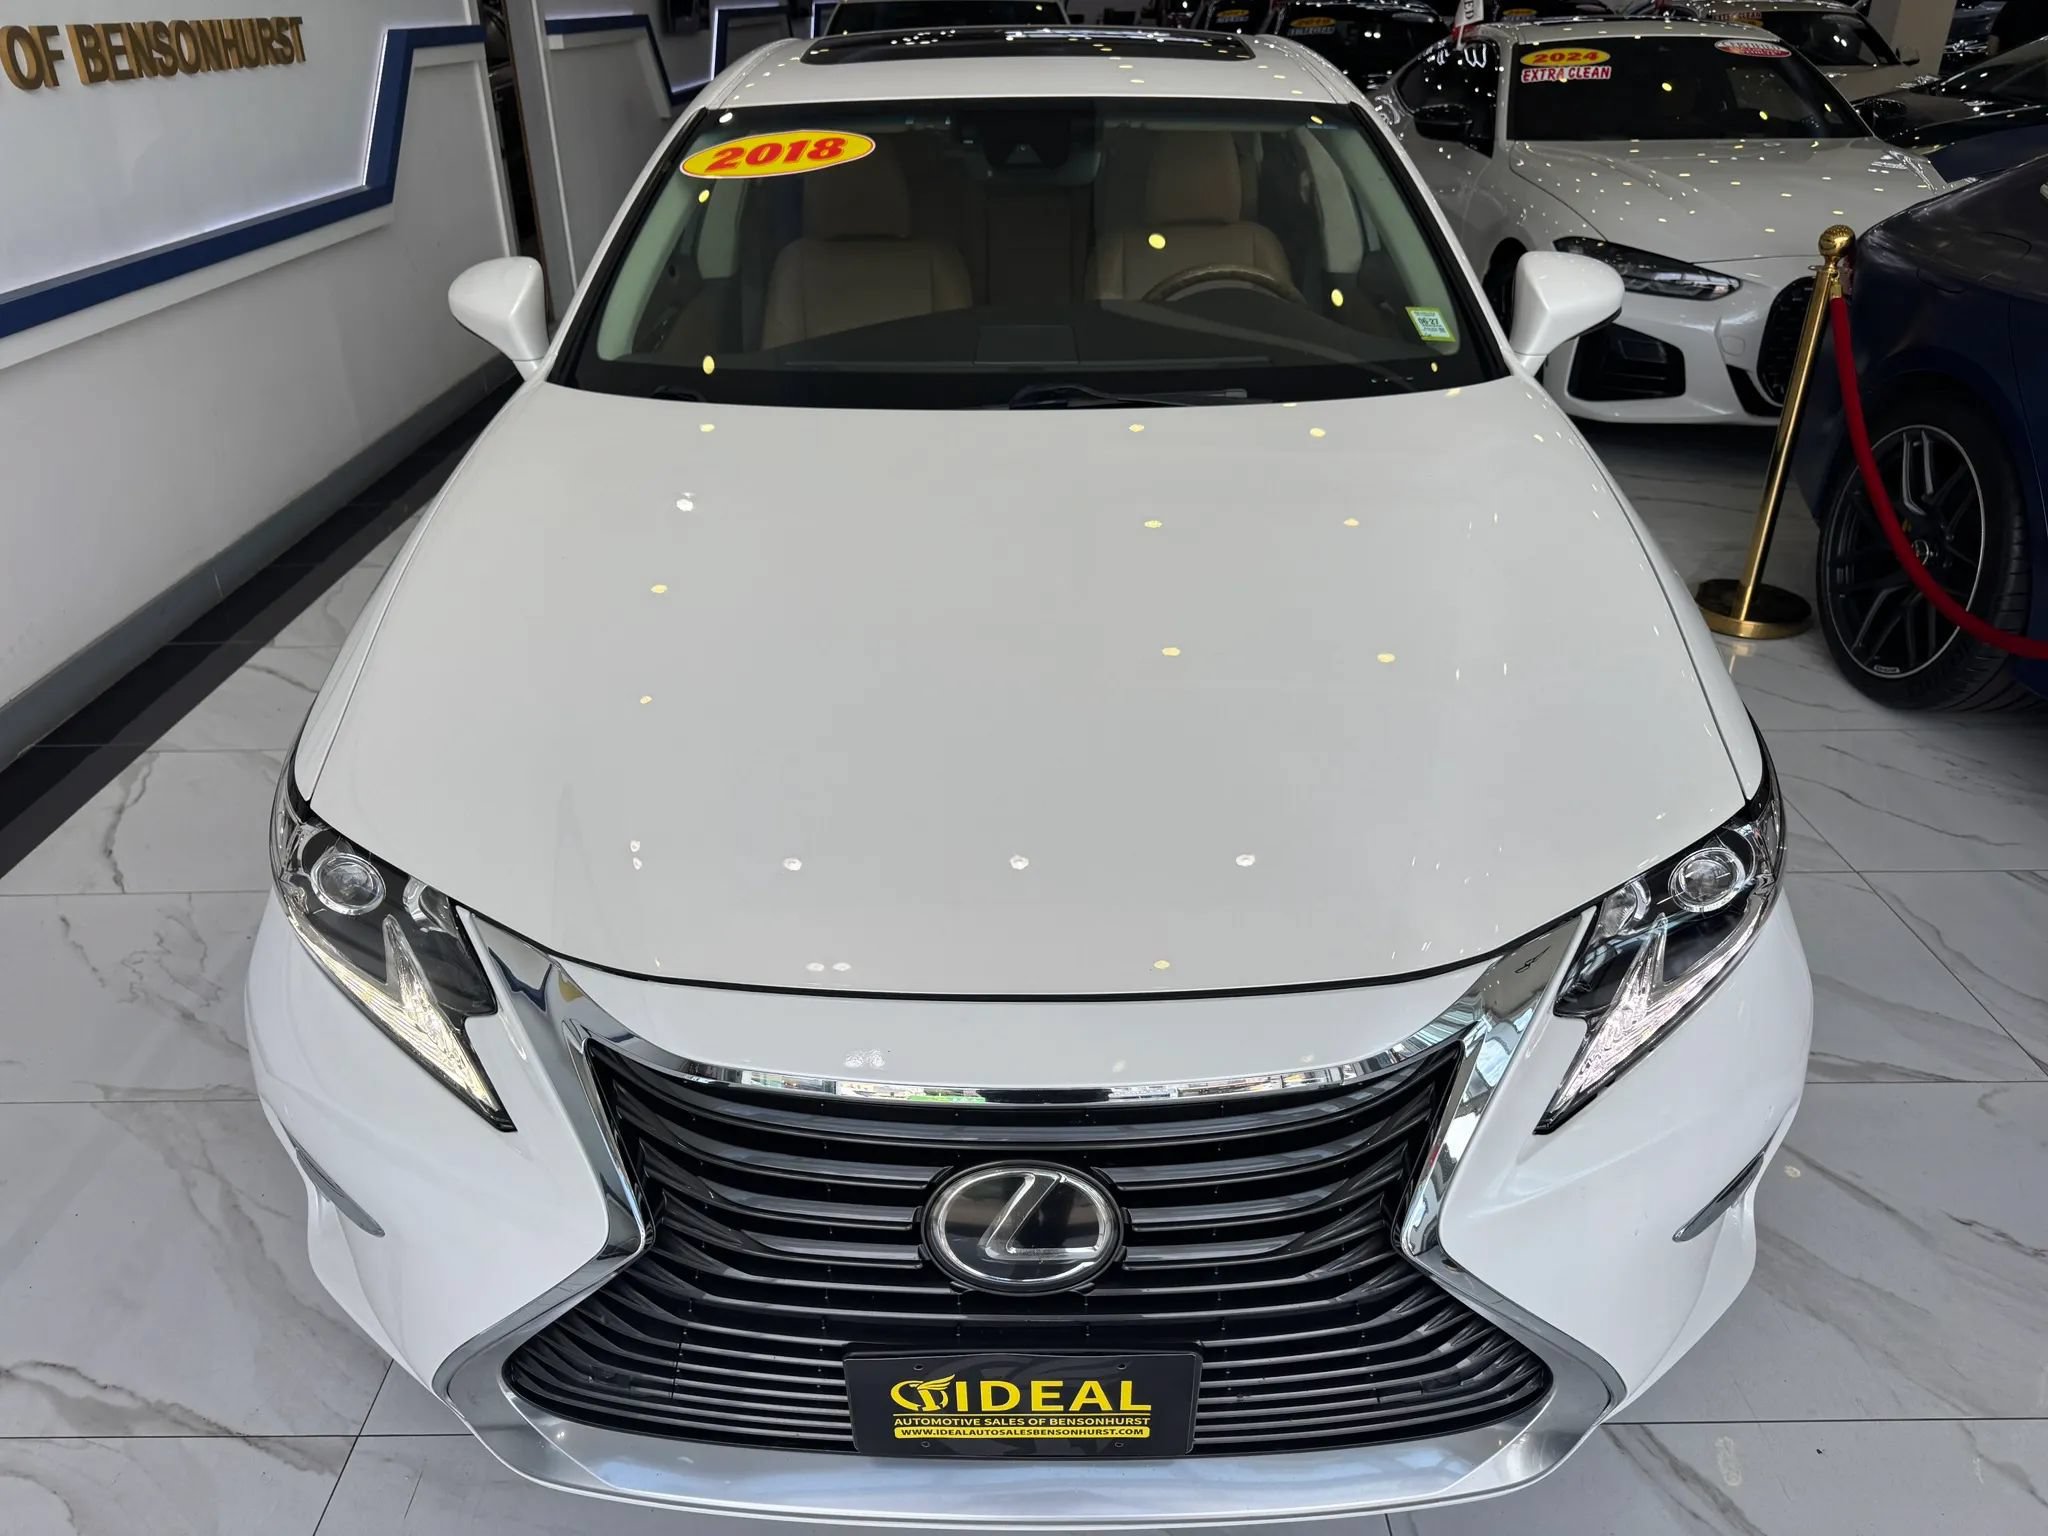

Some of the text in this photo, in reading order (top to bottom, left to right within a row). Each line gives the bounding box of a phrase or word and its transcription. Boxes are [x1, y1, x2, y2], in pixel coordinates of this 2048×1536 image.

[0, 16, 306, 90] OF BENSONHURST
[1533, 51, 1600, 63] 2024
[1522, 66, 1611, 82] EXTRA CLEAN
[705, 138, 847, 172] 2018
[955, 1380, 1152, 1412] IDEAL
[894, 1417, 1151, 1426] AUTOMOTIVE SALES OF BENSONHURST
[901, 1428, 1144, 1436] WWW.IDEALAUTOSALESBENSONHURST.COM
